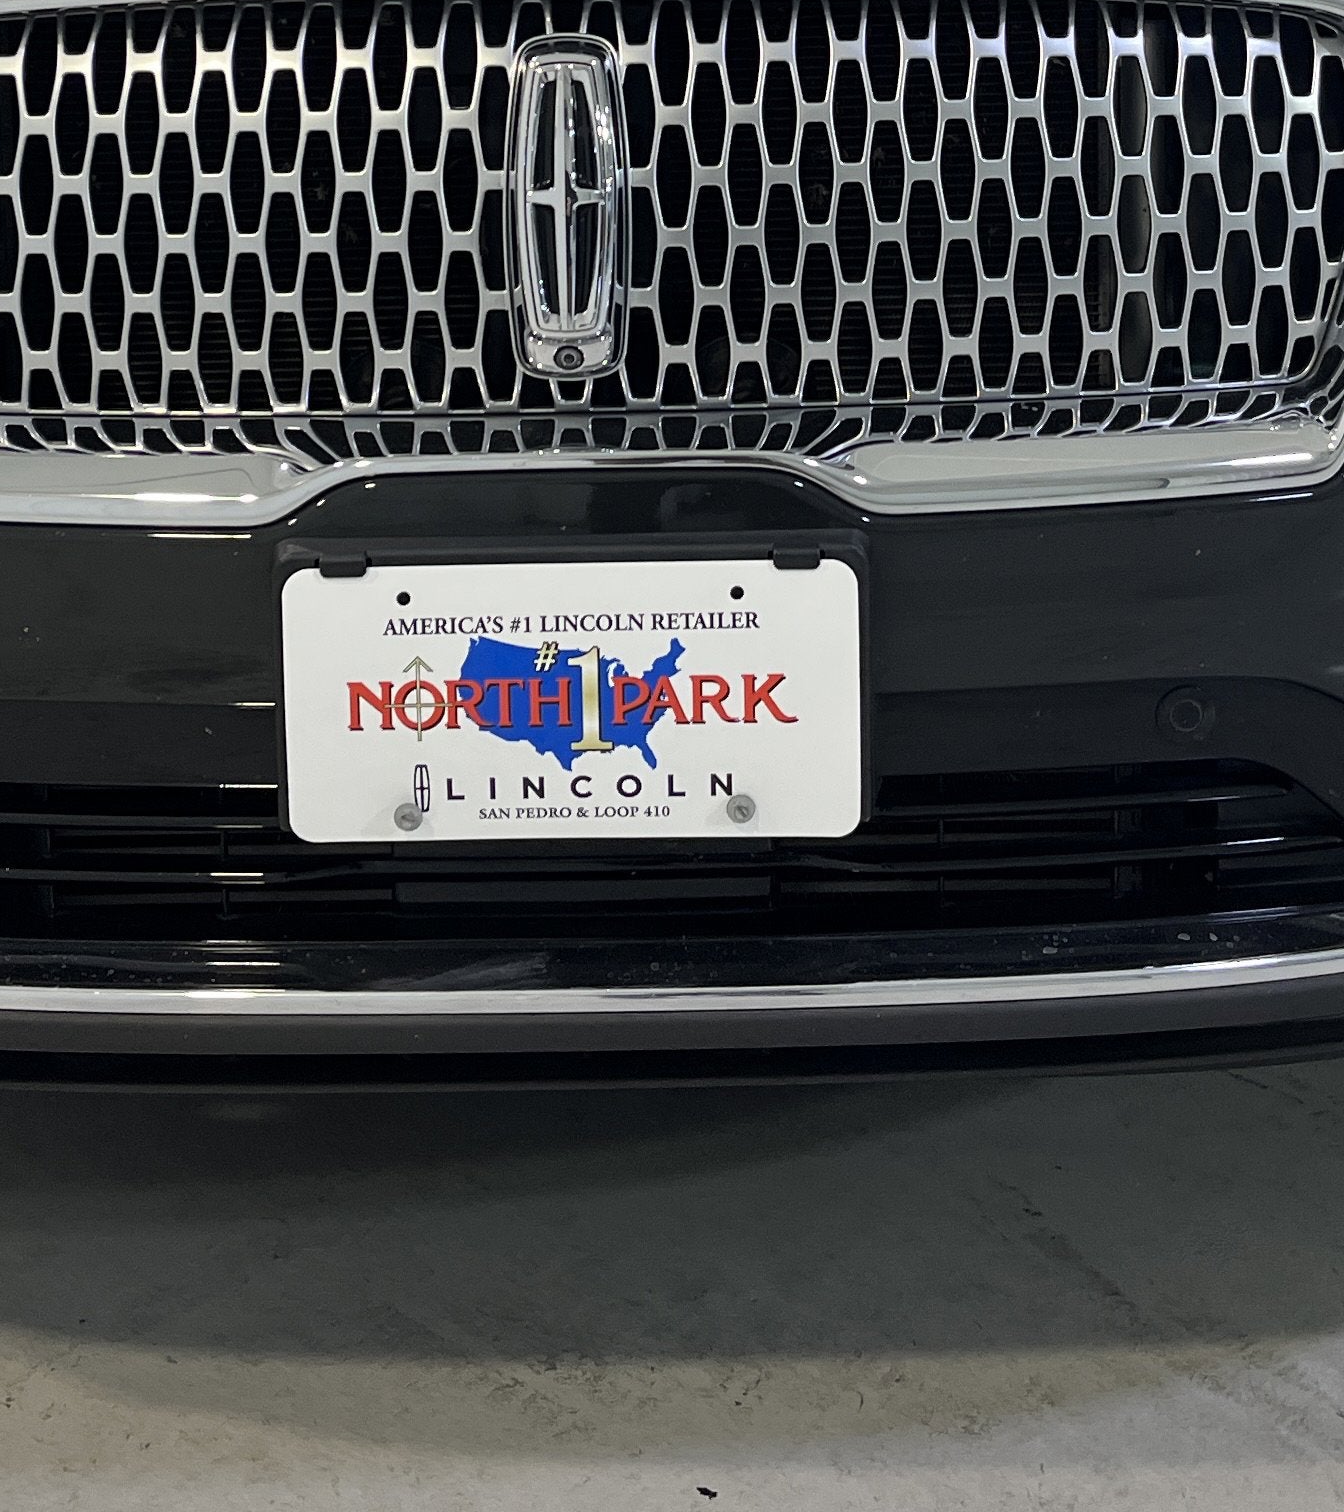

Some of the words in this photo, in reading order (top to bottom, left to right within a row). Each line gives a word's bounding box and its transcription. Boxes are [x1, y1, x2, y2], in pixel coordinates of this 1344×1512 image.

[539, 612, 645, 633] LINCOLN
[650, 610, 760, 631] RETAILER
[347, 679, 572, 731] NORTH
[612, 674, 798, 725] PARK
[446, 773, 733, 800] LINCOLN
[478, 807, 511, 819] SAN
[514, 807, 572, 819] PEDRO
[576, 807, 589, 819] &
[594, 806, 640, 818] LOOP
[644, 806, 671, 818] 410
